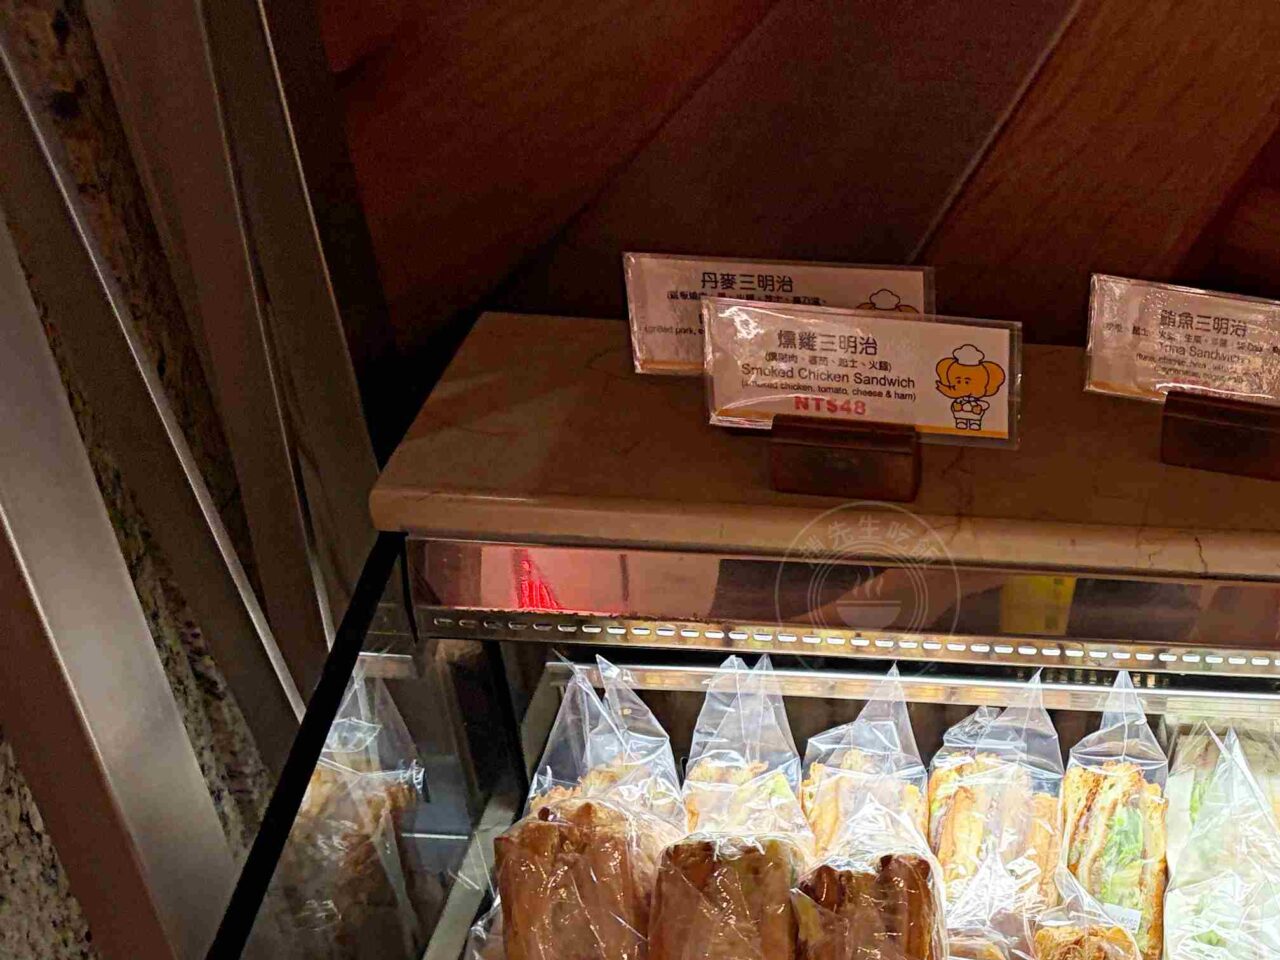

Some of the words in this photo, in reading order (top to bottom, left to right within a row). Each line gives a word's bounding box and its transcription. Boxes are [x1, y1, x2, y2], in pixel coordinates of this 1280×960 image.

[701, 272, 794, 293] 丹麥三明治
[1160, 310, 1248, 338] 鮪魚三明治
[777, 330, 878, 356] 燻雞三明治
[741, 364, 794, 379] Smoked
[798, 368, 850, 383] Chicken
[853, 373, 916, 389] Sandwich
[817, 385, 849, 395] tomato,
[852, 388, 884, 398] cheese
[885, 390, 892, 398] &
[894, 391, 917, 402] ham)
